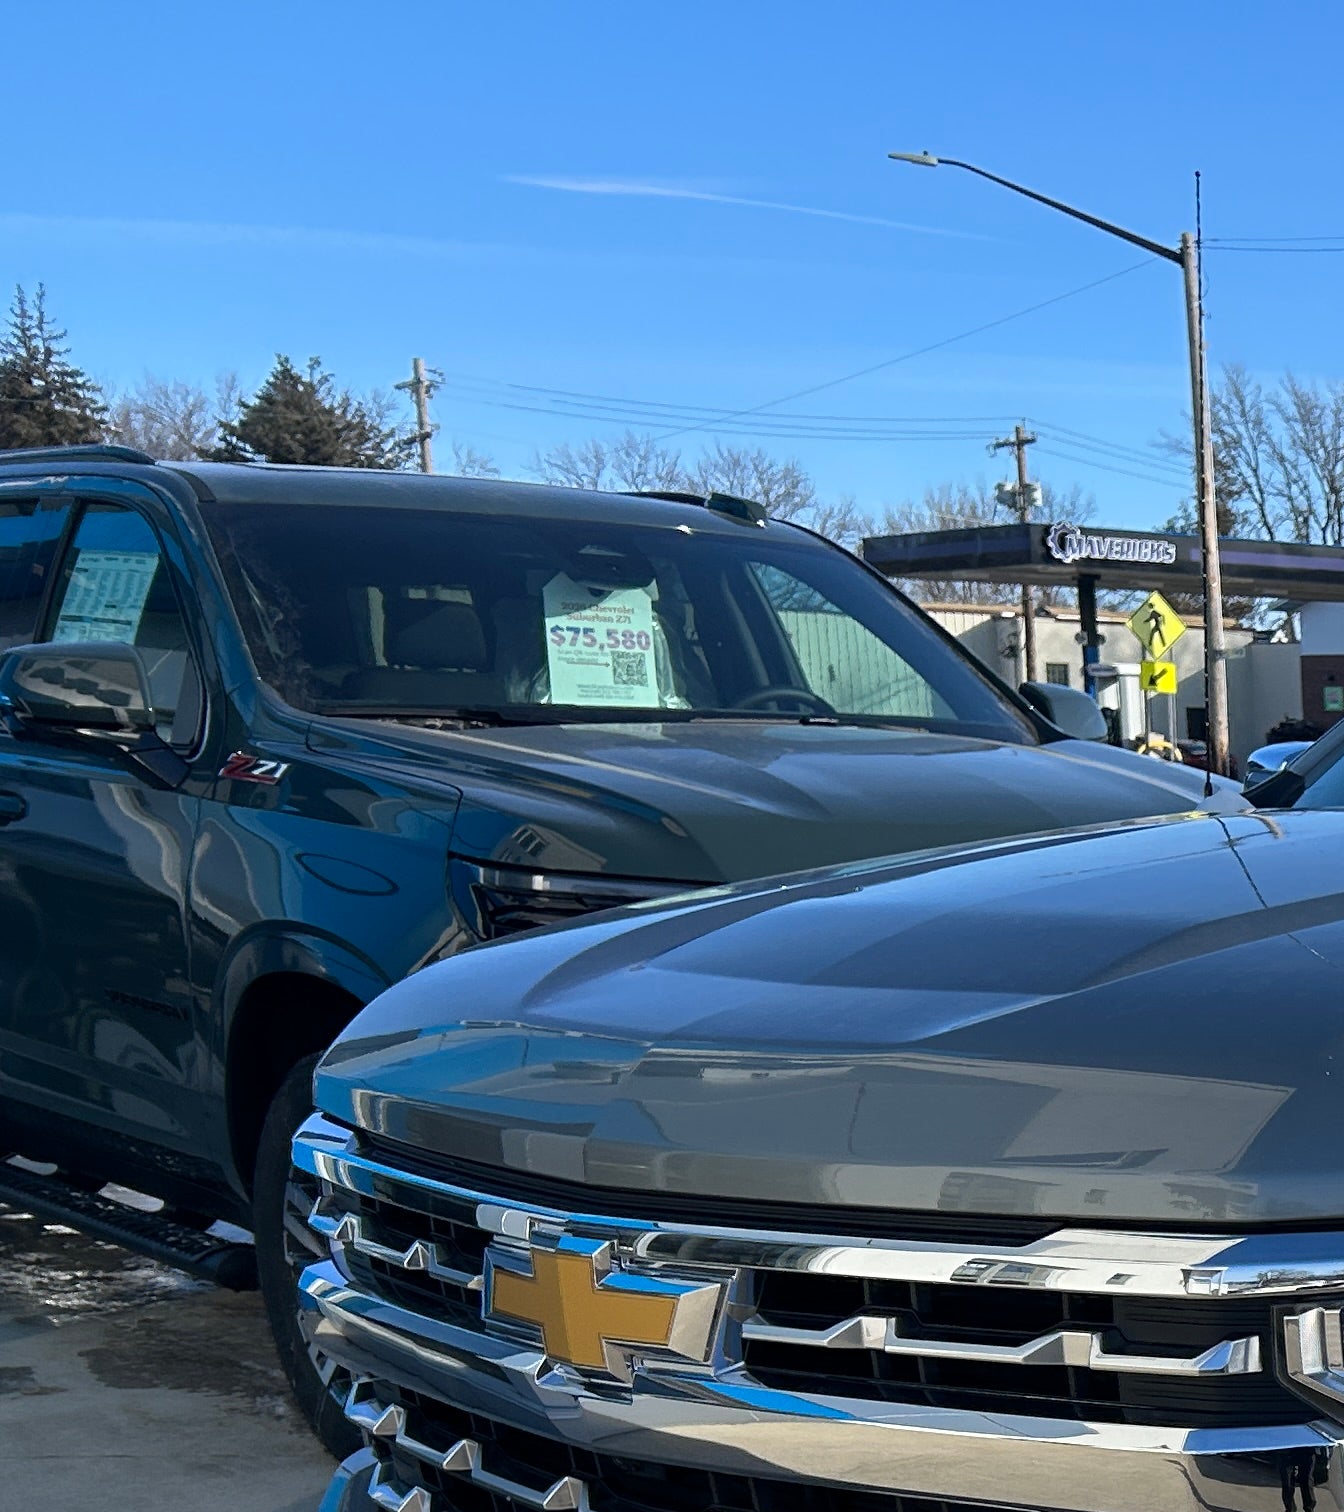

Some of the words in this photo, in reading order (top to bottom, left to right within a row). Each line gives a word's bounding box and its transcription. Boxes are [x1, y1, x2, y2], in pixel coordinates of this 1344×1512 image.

[1065, 533, 1176, 564] MAVERICKS
[550, 625, 651, 652] $75,580
[218, 751, 291, 785] Z71
